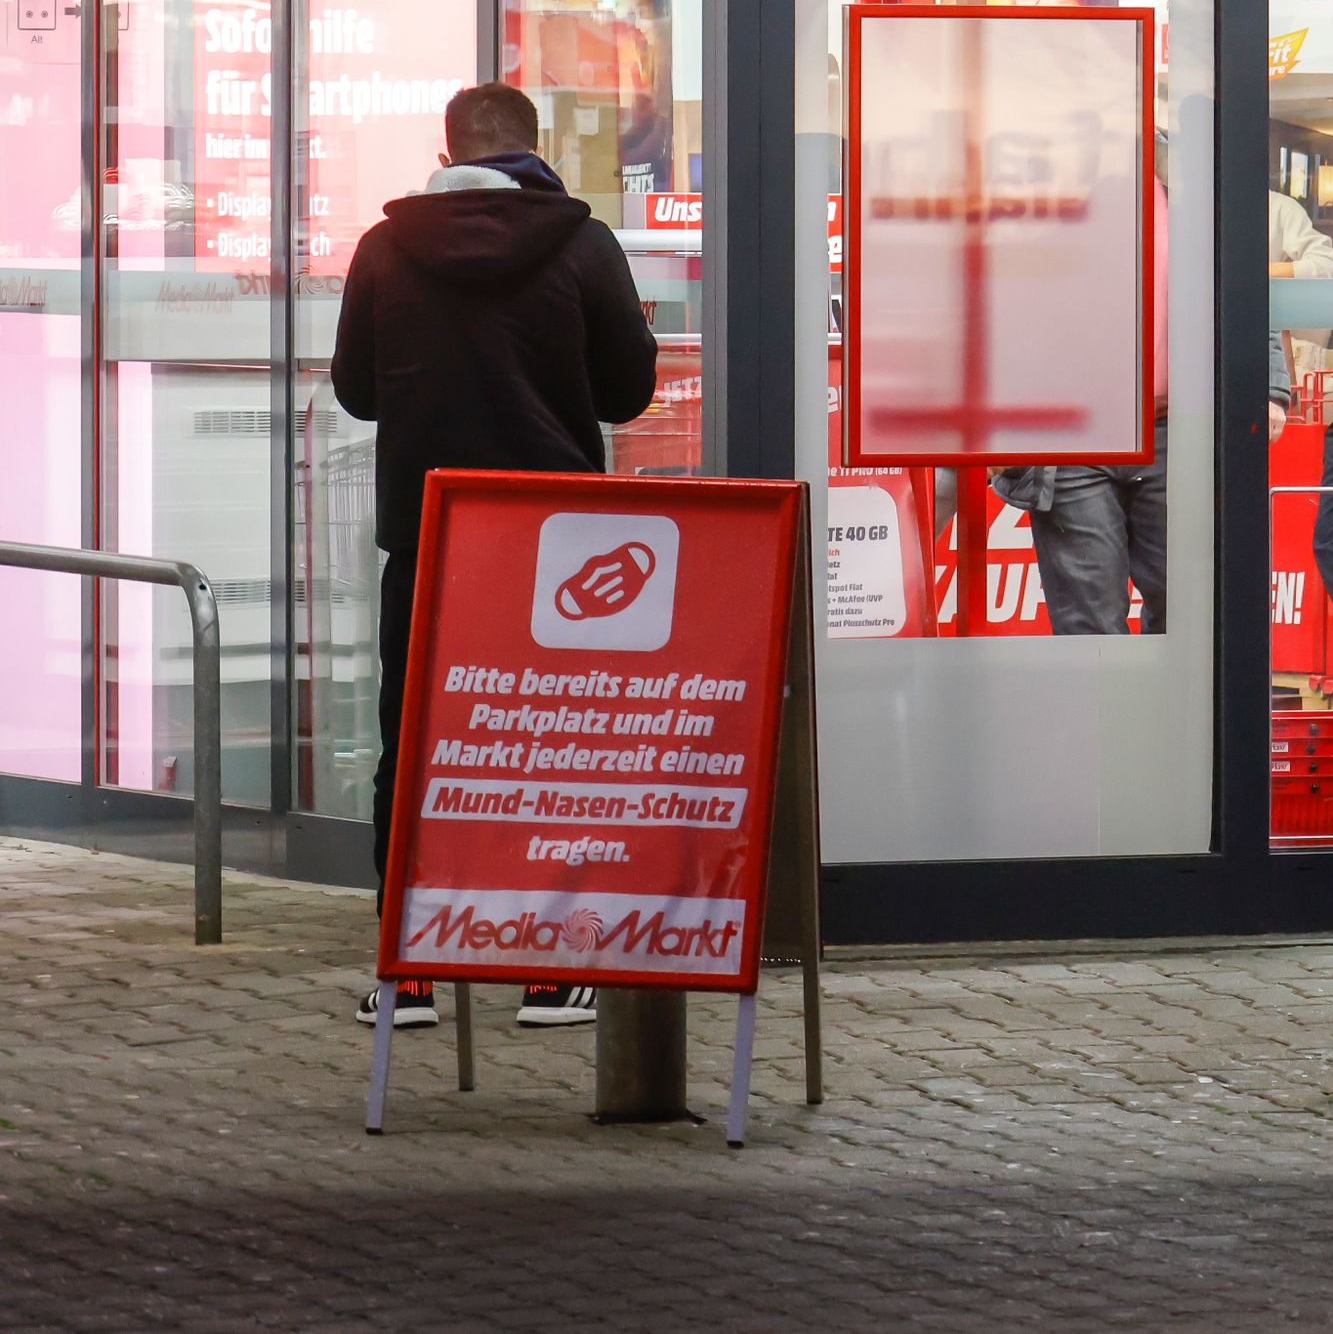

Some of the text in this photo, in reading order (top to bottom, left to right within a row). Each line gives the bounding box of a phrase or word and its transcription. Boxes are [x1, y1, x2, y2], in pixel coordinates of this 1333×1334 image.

[206, 69, 463, 124] für Sartphone
[206, 132, 240, 159] hier
[846, 526, 866, 541] 40
[869, 525, 889, 541] GB
[837, 594, 883, 604] McAfee (UVP
[849, 583, 863, 592] Flat
[845, 607, 863, 615] dazu
[882, 618, 895, 626] Pro
[444, 666, 746, 702] Bitte bereits auf dem
[468, 703, 715, 737] Parkplatz und im
[430, 739, 745, 776] Markt jederzeit einen
[432, 786, 737, 823] Mund-Nasen-Schutz
[526, 834, 631, 866] tragen.
[404, 904, 740, 958] Media Markt
